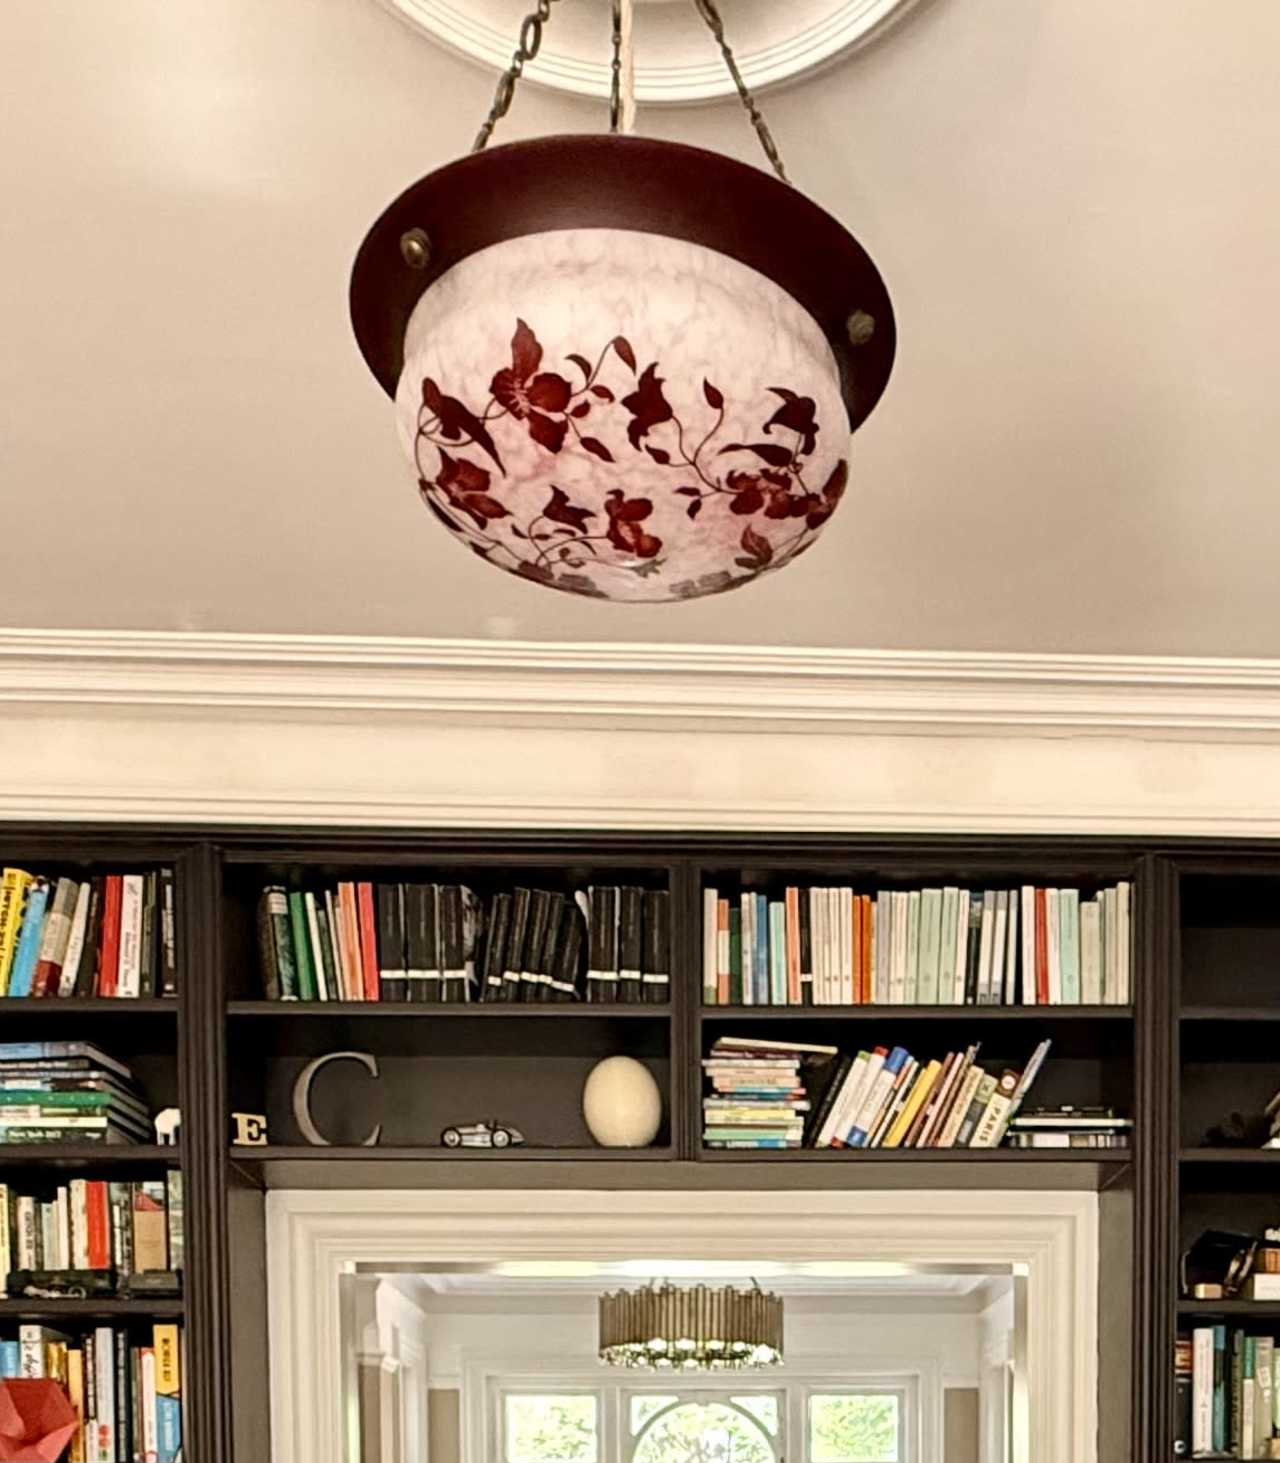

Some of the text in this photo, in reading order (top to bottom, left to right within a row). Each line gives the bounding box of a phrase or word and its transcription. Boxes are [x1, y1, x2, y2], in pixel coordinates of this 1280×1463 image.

[292, 1050, 382, 1147] C
[232, 1112, 268, 1145] E
[978, 1103, 1003, 1144] PARIS
